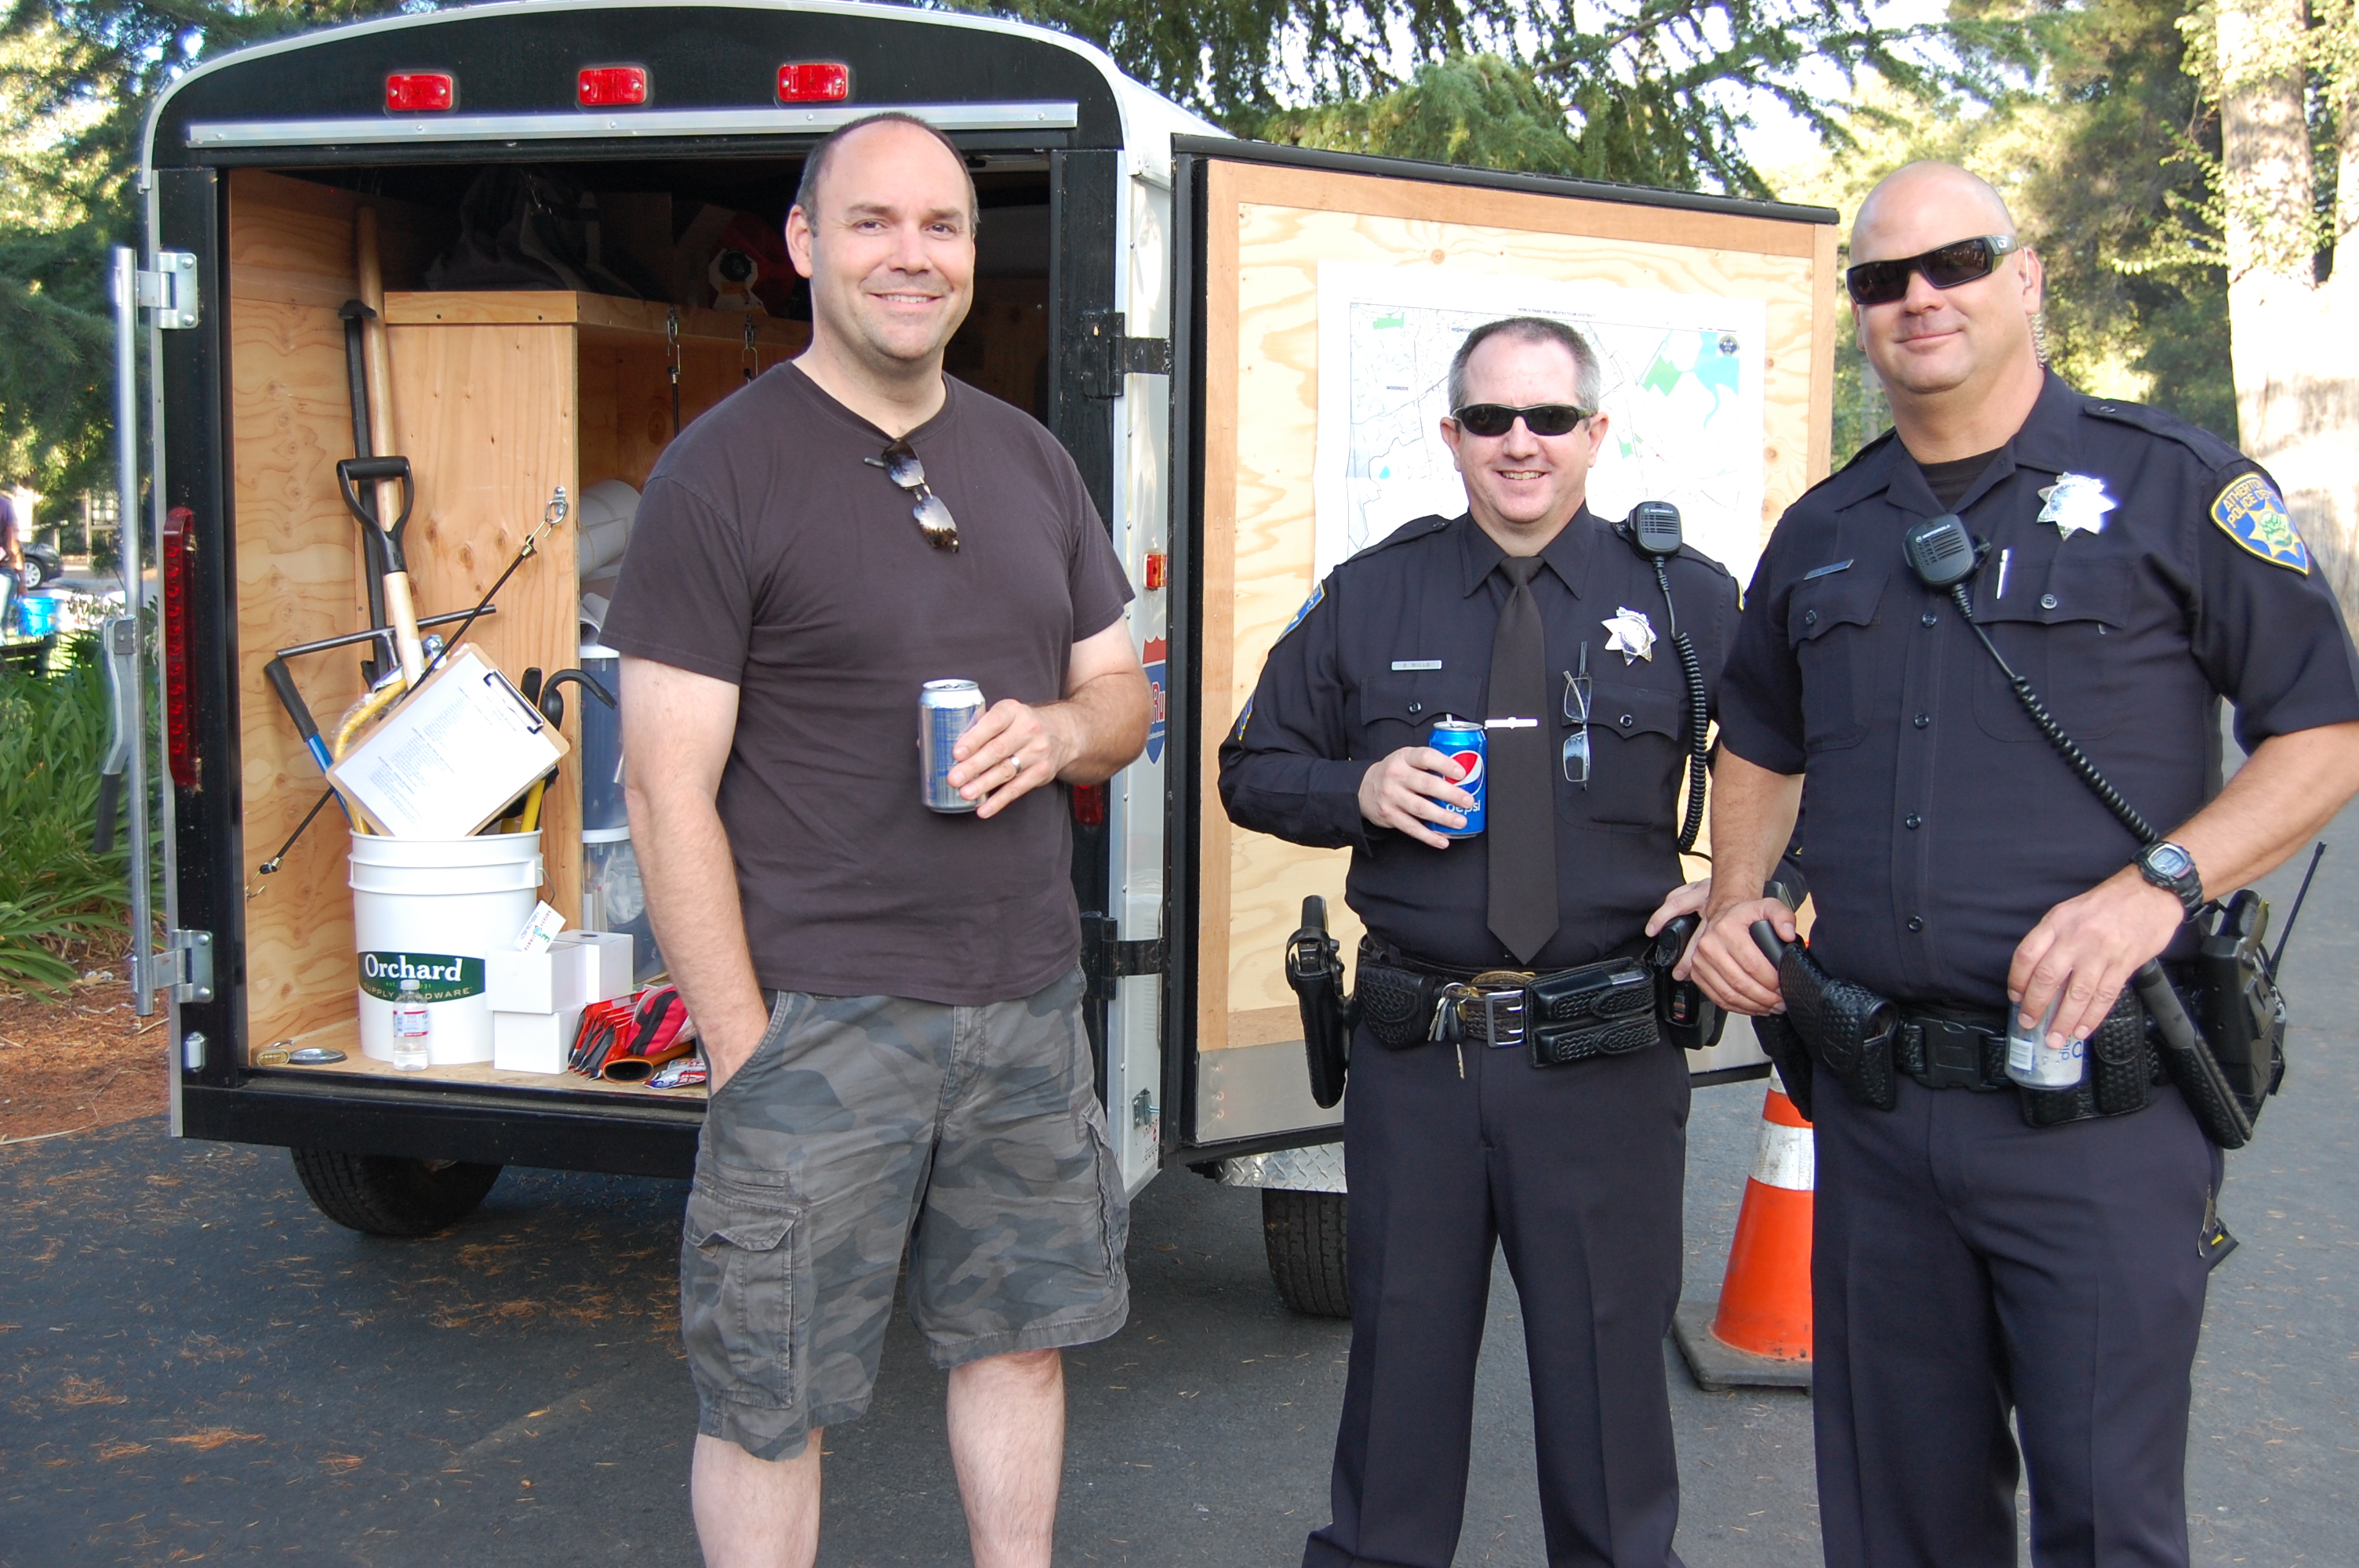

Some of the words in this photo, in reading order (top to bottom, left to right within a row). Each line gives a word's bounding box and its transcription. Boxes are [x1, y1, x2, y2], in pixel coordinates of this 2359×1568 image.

[2227, 492, 2259, 529] POLICE
[1922, 524, 1951, 539] MOTOROLA
[365, 953, 463, 982] Orchard
[363, 982, 394, 999] SUPPLY
[2059, 1034, 2071, 1061] die
